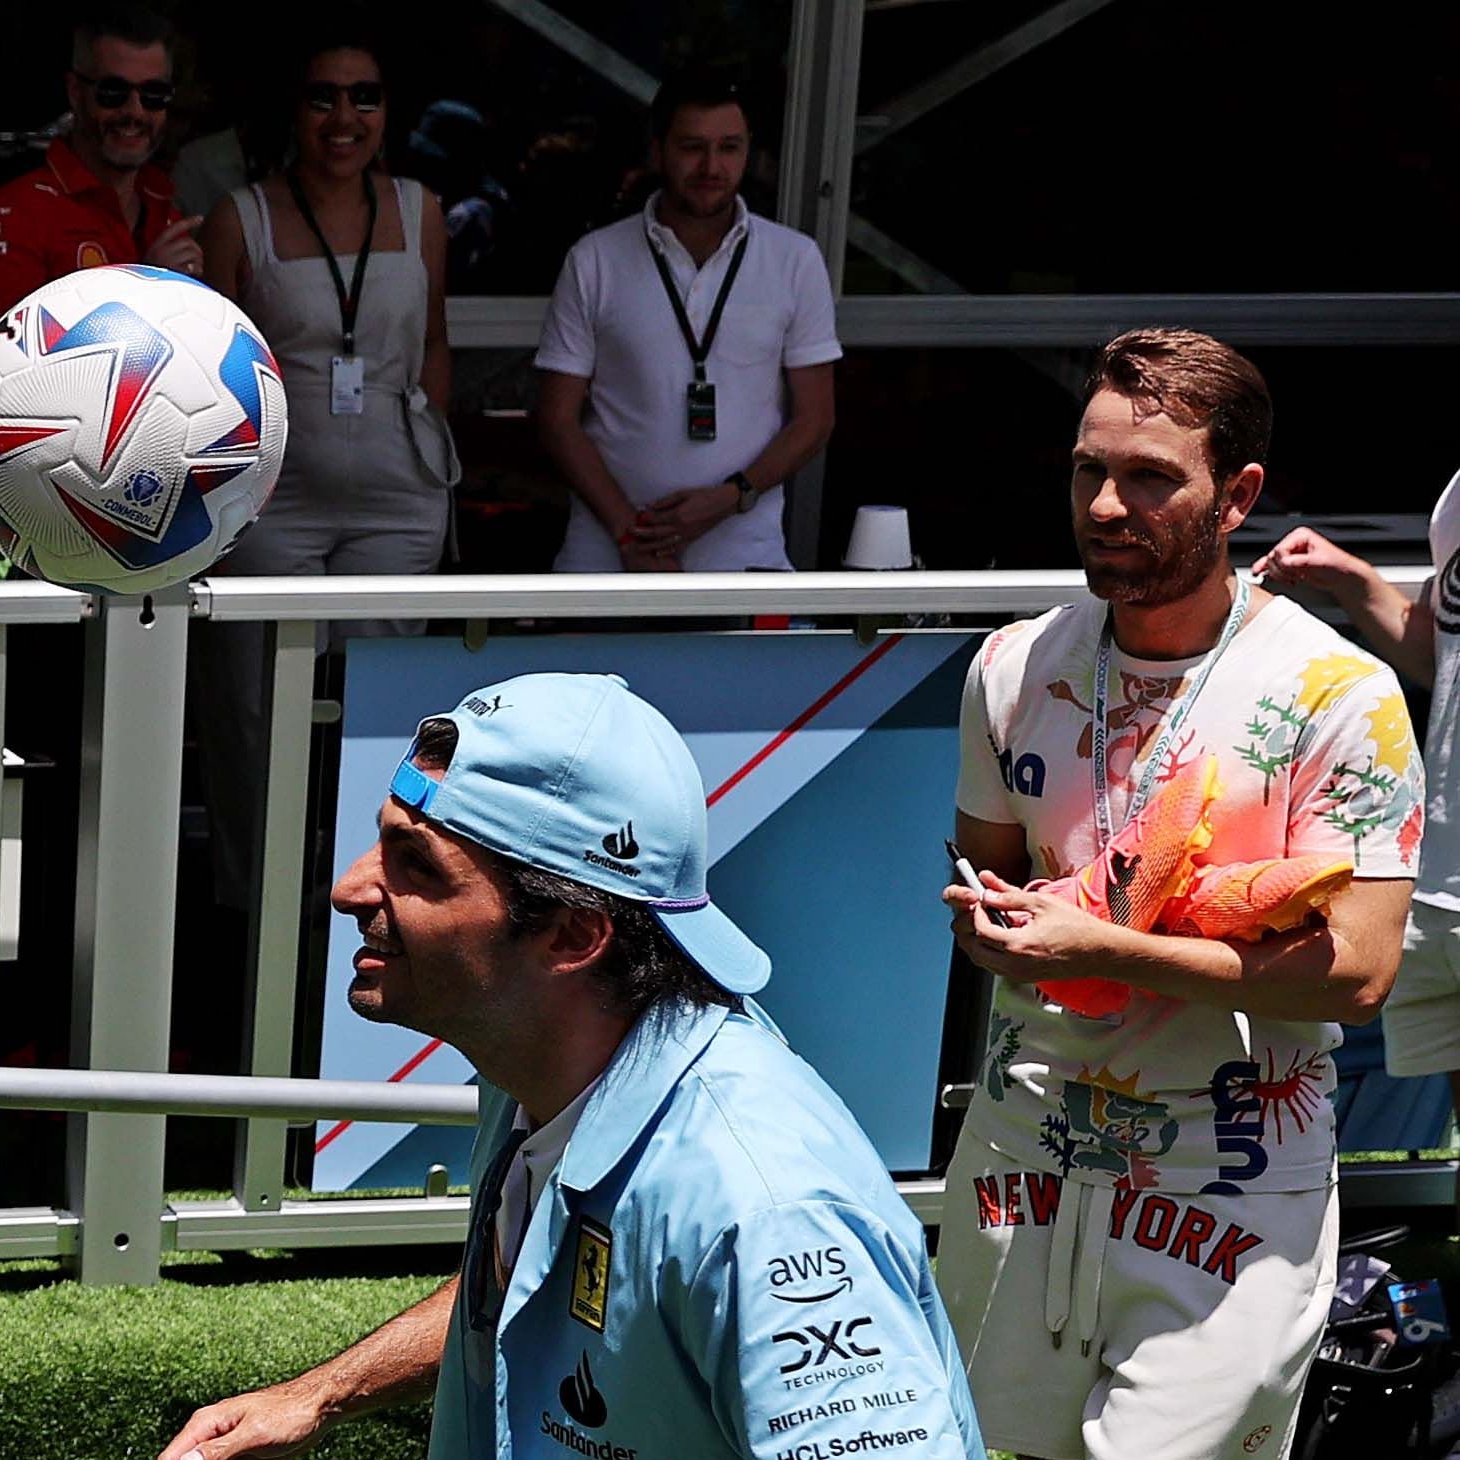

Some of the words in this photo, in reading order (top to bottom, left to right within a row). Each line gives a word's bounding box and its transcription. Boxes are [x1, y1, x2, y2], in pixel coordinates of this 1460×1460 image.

[102, 499, 154, 527] CONMEBOL
[583, 849, 642, 878] Santander
[973, 1172, 1063, 1230] NEW
[1108, 1187, 1264, 1287] YORK
[767, 1246, 847, 1288] aws
[771, 1316, 882, 1375] DXC
[782, 1360, 886, 1391] TECHNOLOGY
[768, 1398, 857, 1435] RICHARD
[863, 1389, 918, 1410] MILLE
